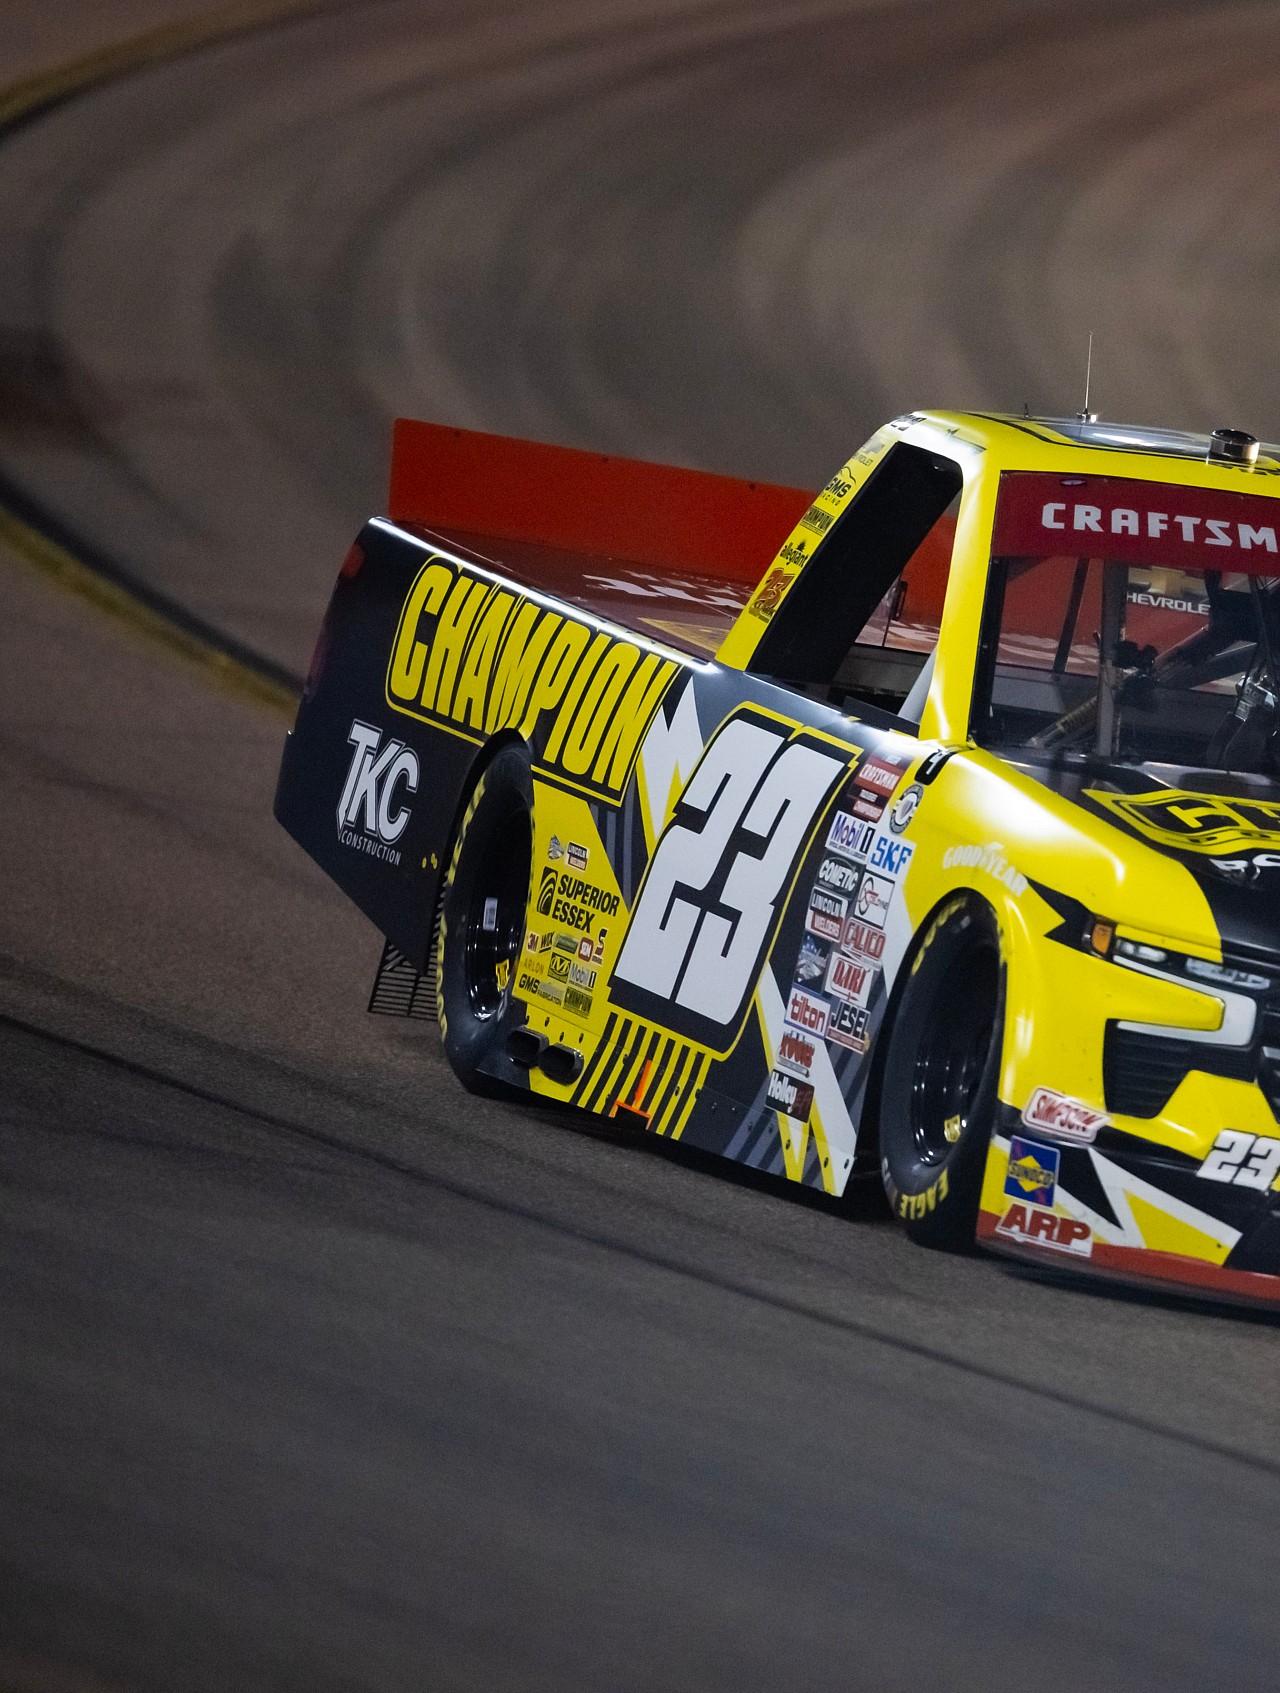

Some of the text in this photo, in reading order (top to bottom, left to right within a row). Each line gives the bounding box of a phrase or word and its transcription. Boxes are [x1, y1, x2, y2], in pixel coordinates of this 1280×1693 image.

[1126, 592, 1211, 615] HEVROLE
[391, 564, 679, 791] CHAMPION
[336, 718, 420, 845] TKC
[341, 830, 402, 866] CONSTRUCTION
[831, 814, 866, 850] Mobil
[859, 826, 876, 854] 1
[614, 718, 845, 1025] 23
[870, 836, 912, 875] SKF
[943, 842, 1028, 897] GOODYEAR
[818, 859, 859, 892] COMETIC
[557, 874, 620, 917] SUPERIOR
[811, 892, 843, 918] LINCOLN
[551, 898, 596, 933] ESSEX
[527, 933, 539, 952] 3M
[843, 921, 886, 959] CALICO
[518, 973, 541, 995] GMS
[790, 992, 826, 1033] tilton
[830, 1001, 871, 1041] JESEL
[767, 1071, 798, 1112] Holley
[1008, 1160, 1056, 1188] SUNOCO
[1000, 1203, 1092, 1246] ARP
